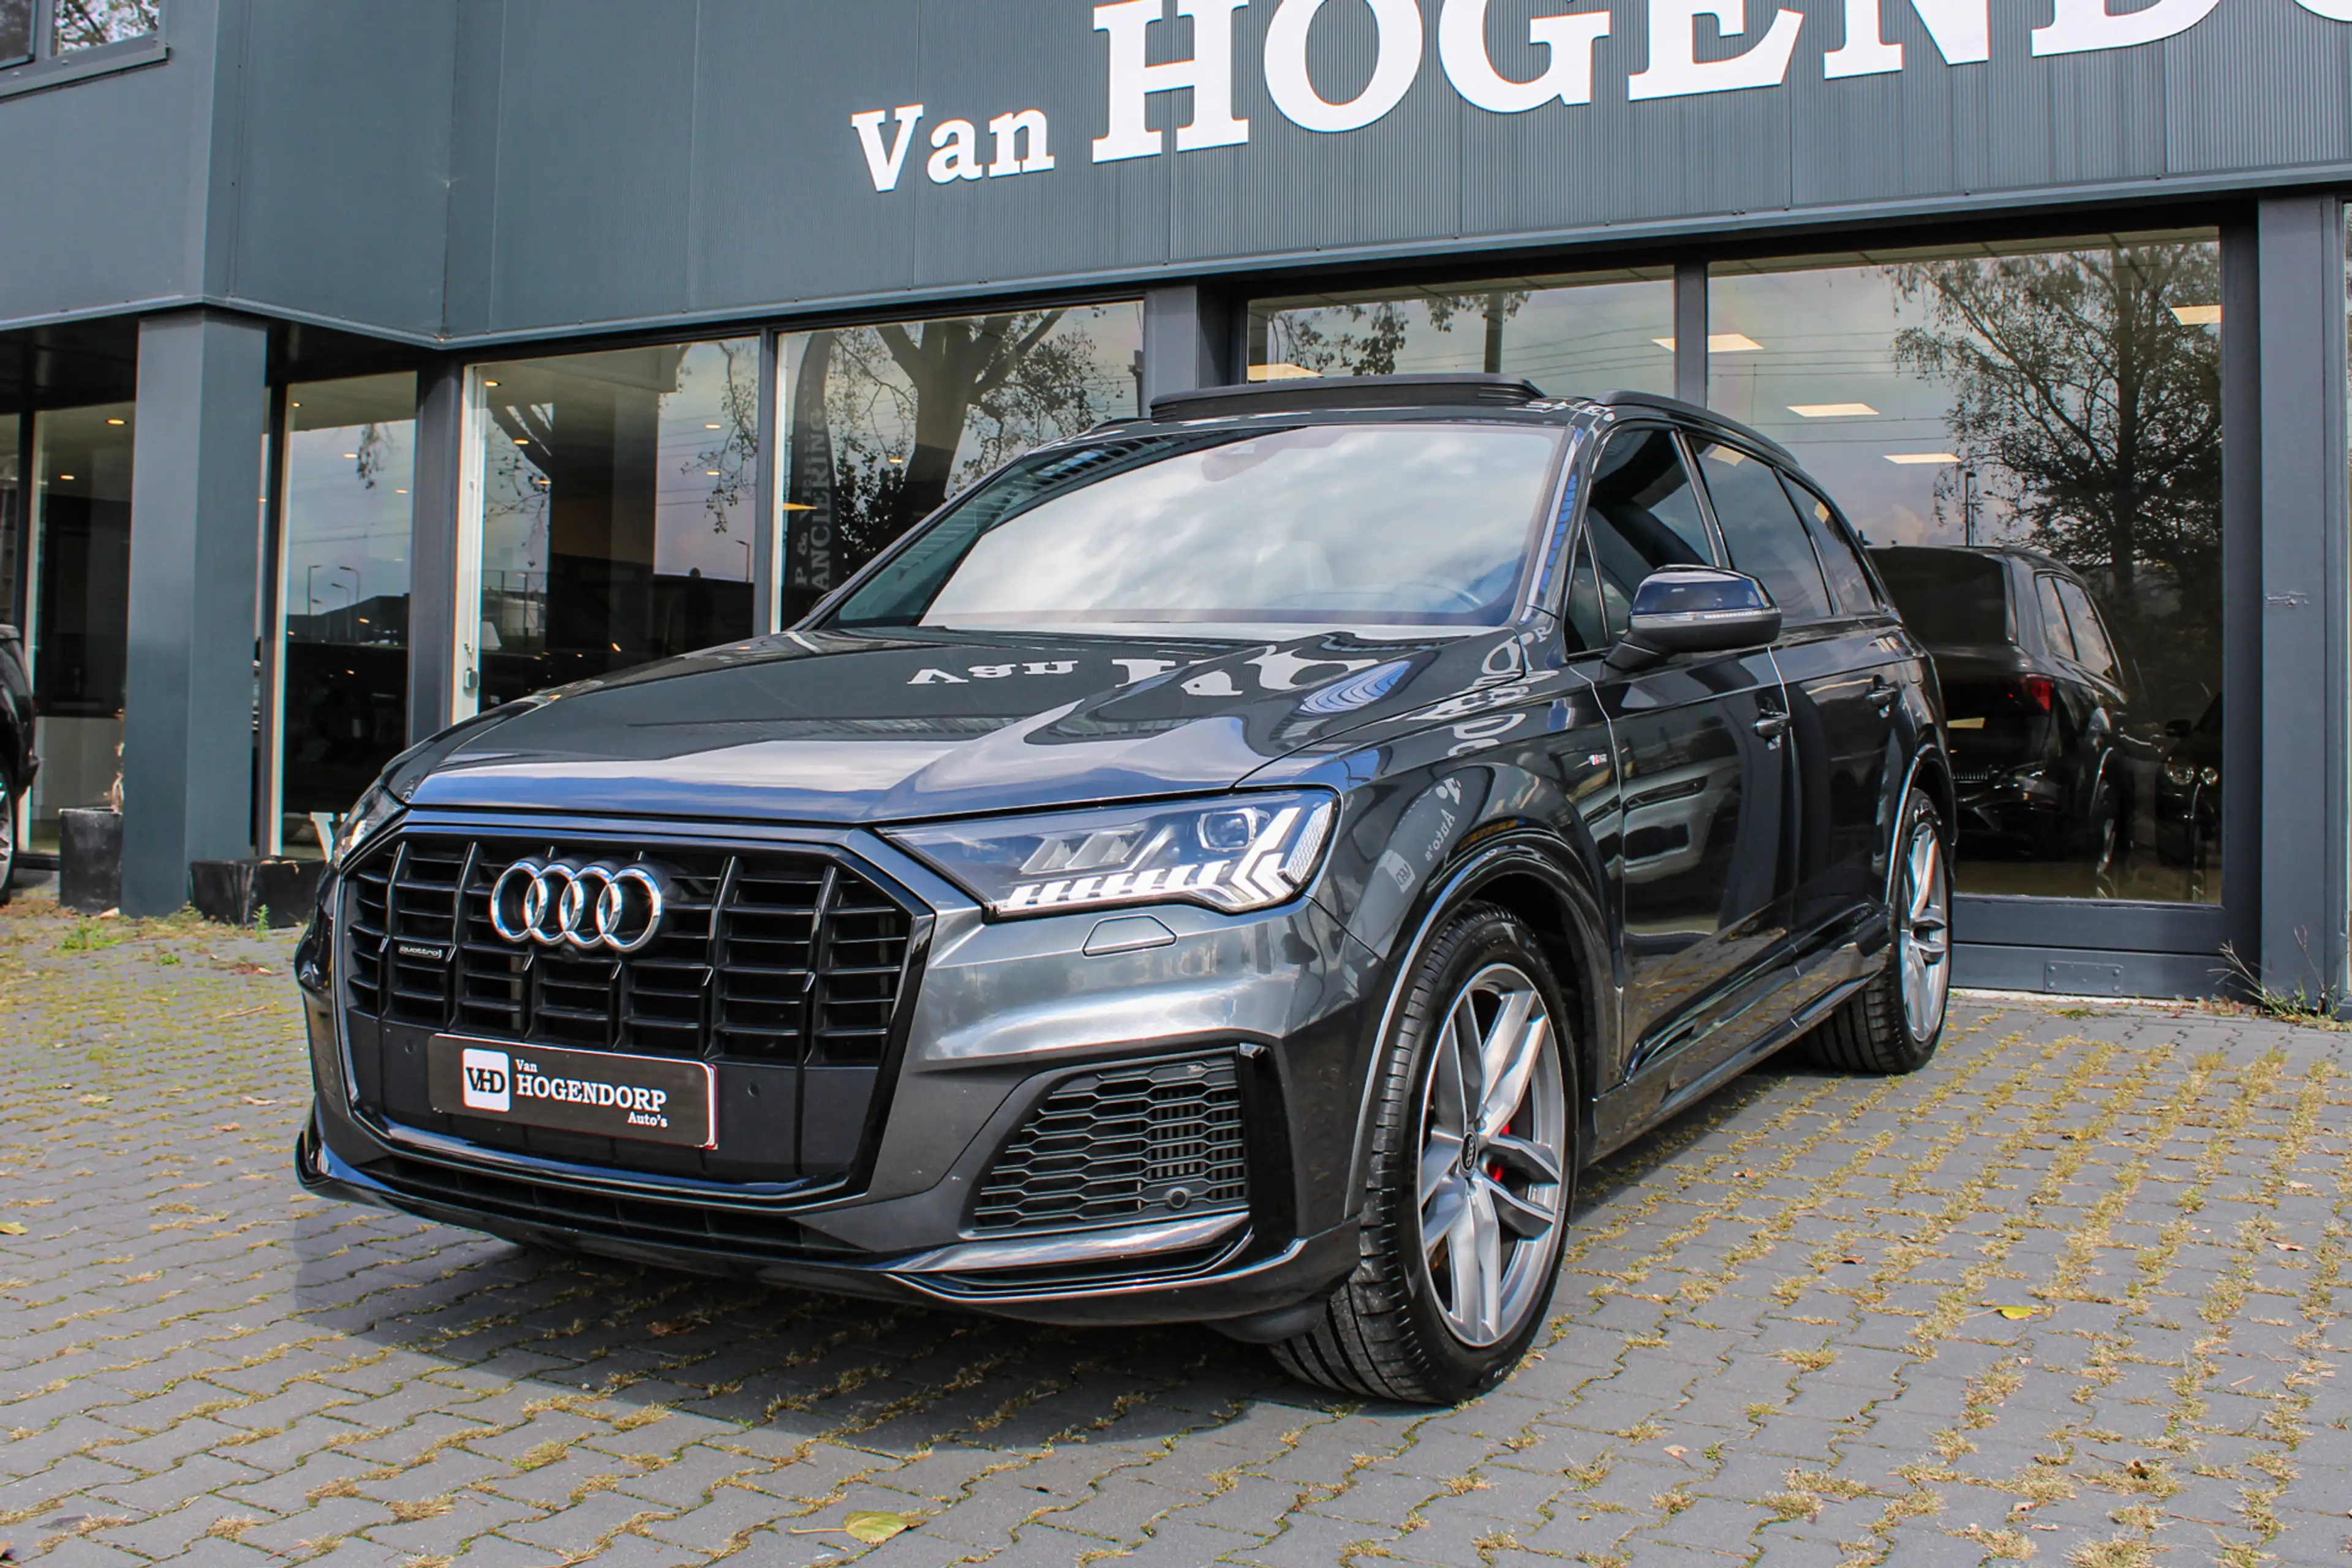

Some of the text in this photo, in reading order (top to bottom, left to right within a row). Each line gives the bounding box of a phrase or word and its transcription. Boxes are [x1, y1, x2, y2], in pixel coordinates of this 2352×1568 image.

[851, 104, 1055, 193] Van
[514, 1058, 537, 1072] Van
[515, 1074, 666, 1112] HOGENDORP
[627, 1111, 668, 1128] Auto's
